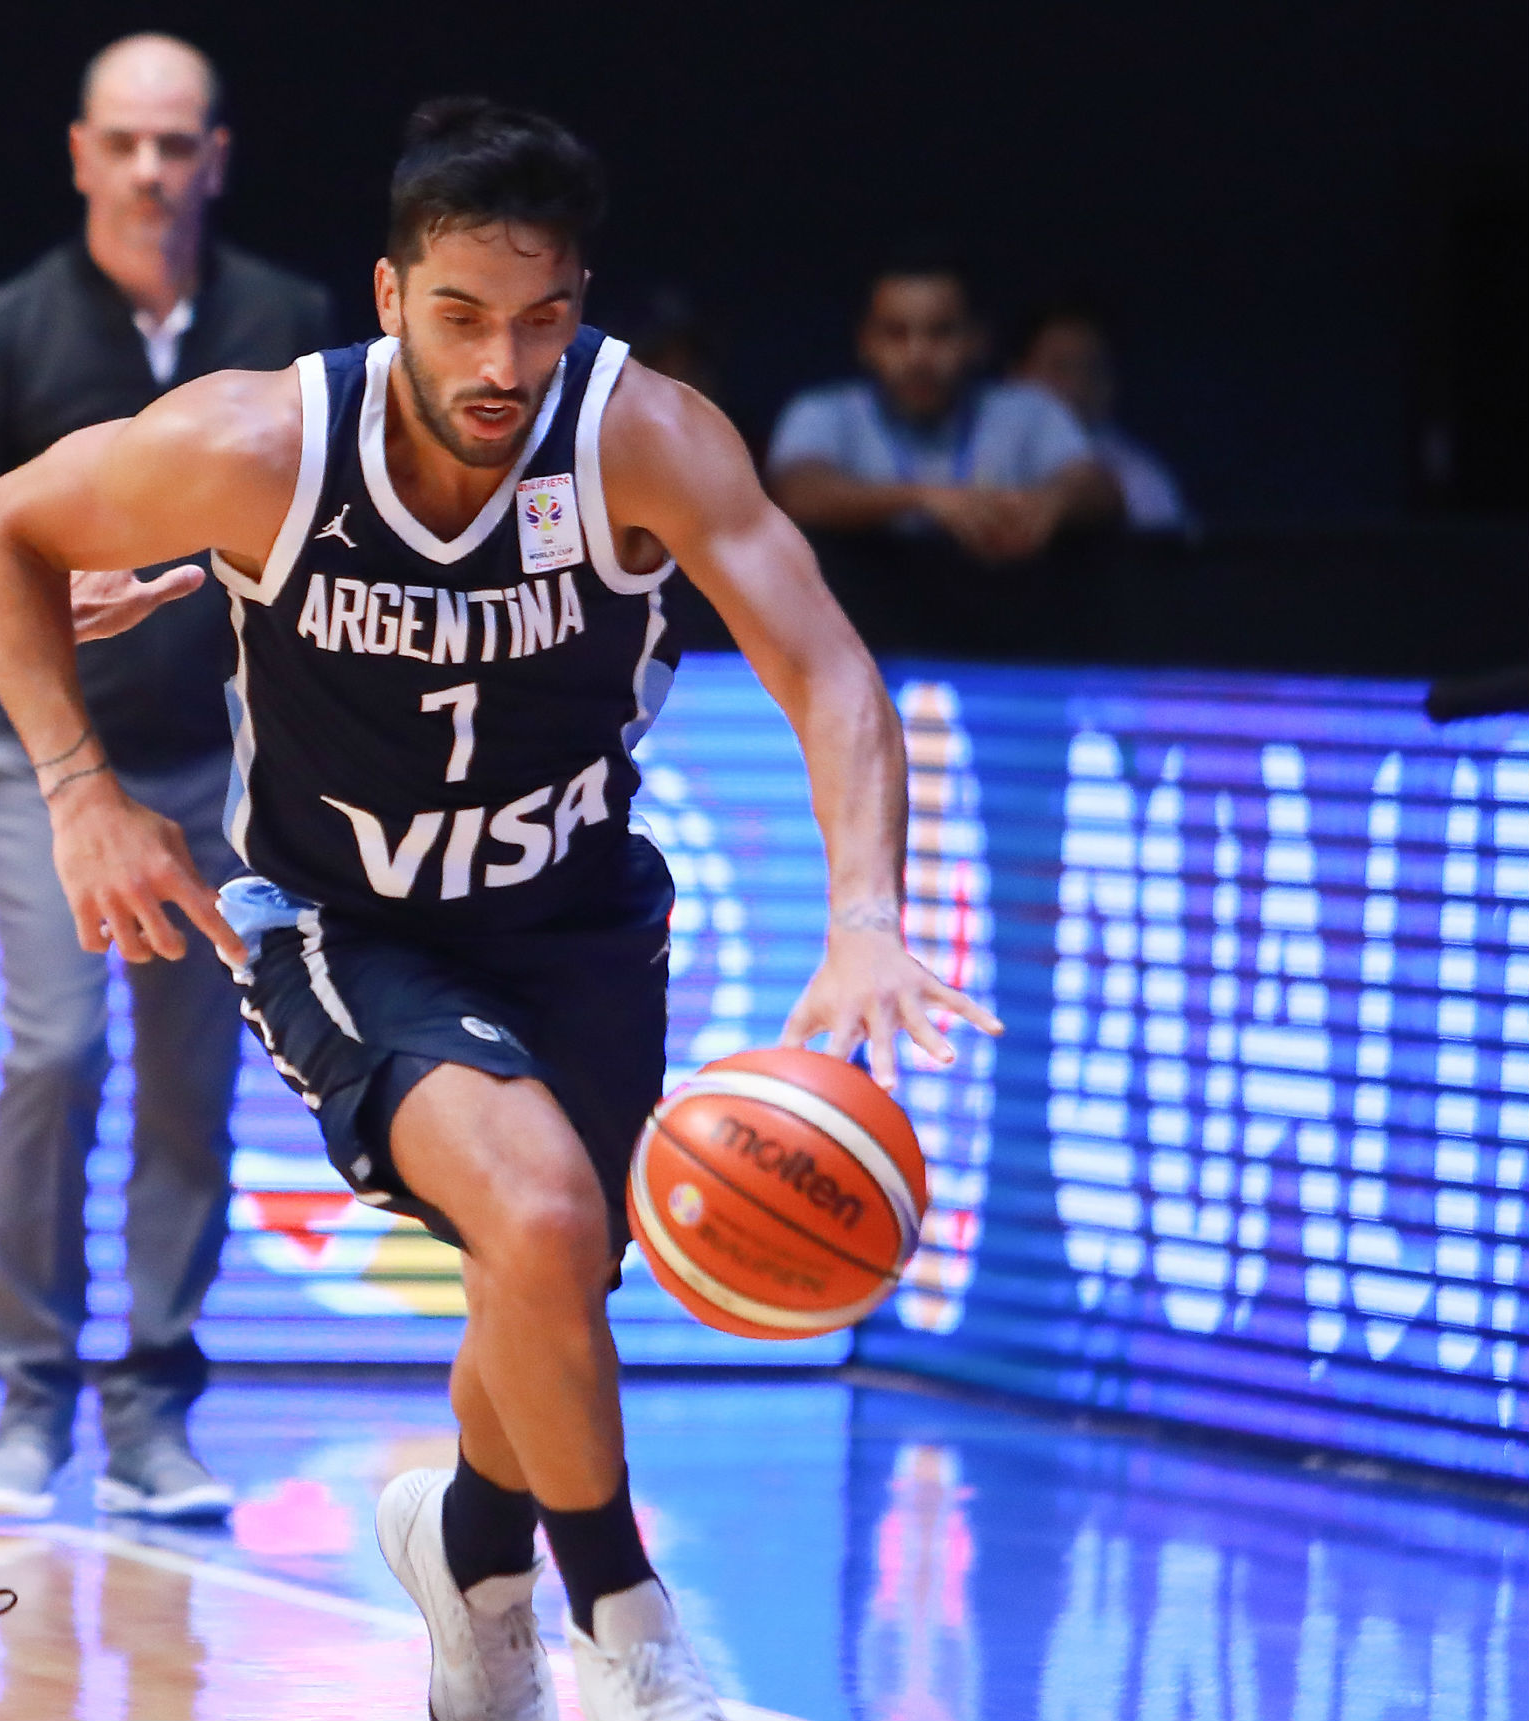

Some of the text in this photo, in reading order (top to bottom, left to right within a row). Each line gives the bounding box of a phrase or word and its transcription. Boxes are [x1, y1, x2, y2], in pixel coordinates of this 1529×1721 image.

[297, 573, 585, 664] ARGENTINA
[420, 682, 479, 783] 7
[320, 755, 611, 900] VISA
[709, 1114, 865, 1233] molten
